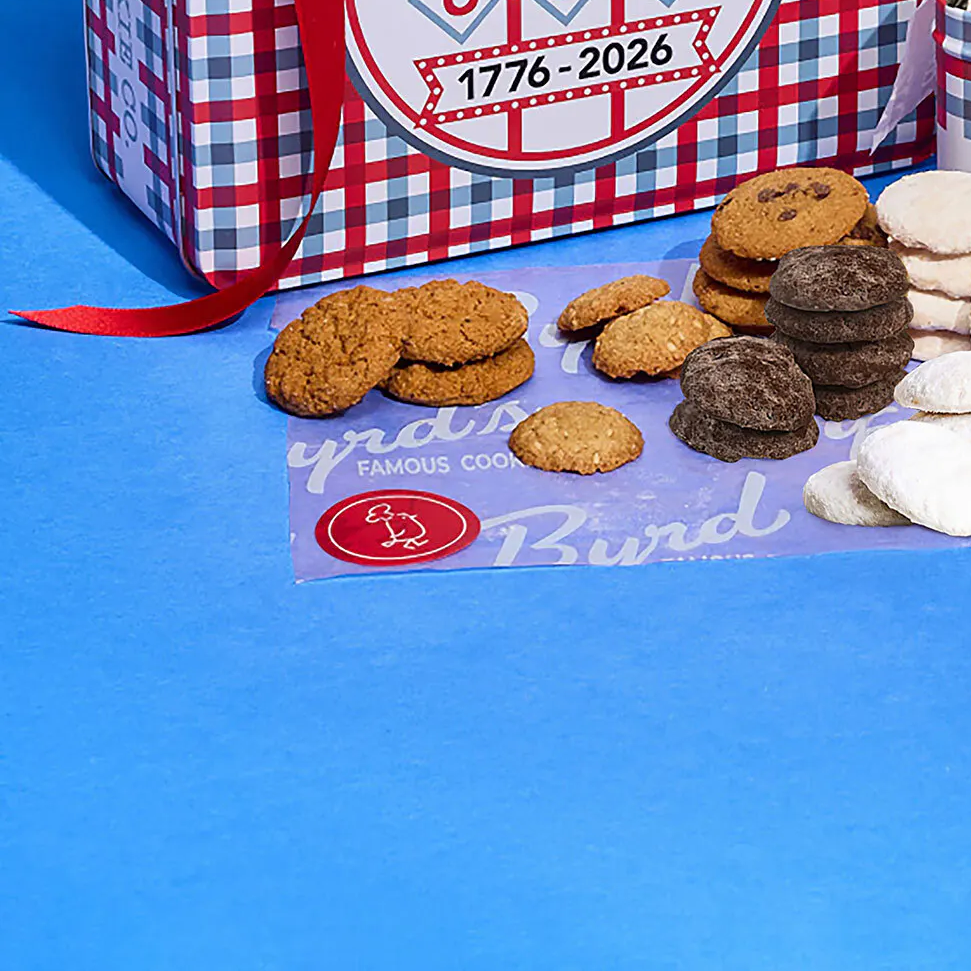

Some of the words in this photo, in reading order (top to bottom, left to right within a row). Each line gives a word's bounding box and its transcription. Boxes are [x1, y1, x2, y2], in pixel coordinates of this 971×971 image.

[120, 78, 138, 148] CO.
[356, 455, 451, 477] FAMOUS
[460, 451, 526, 472] COOK
